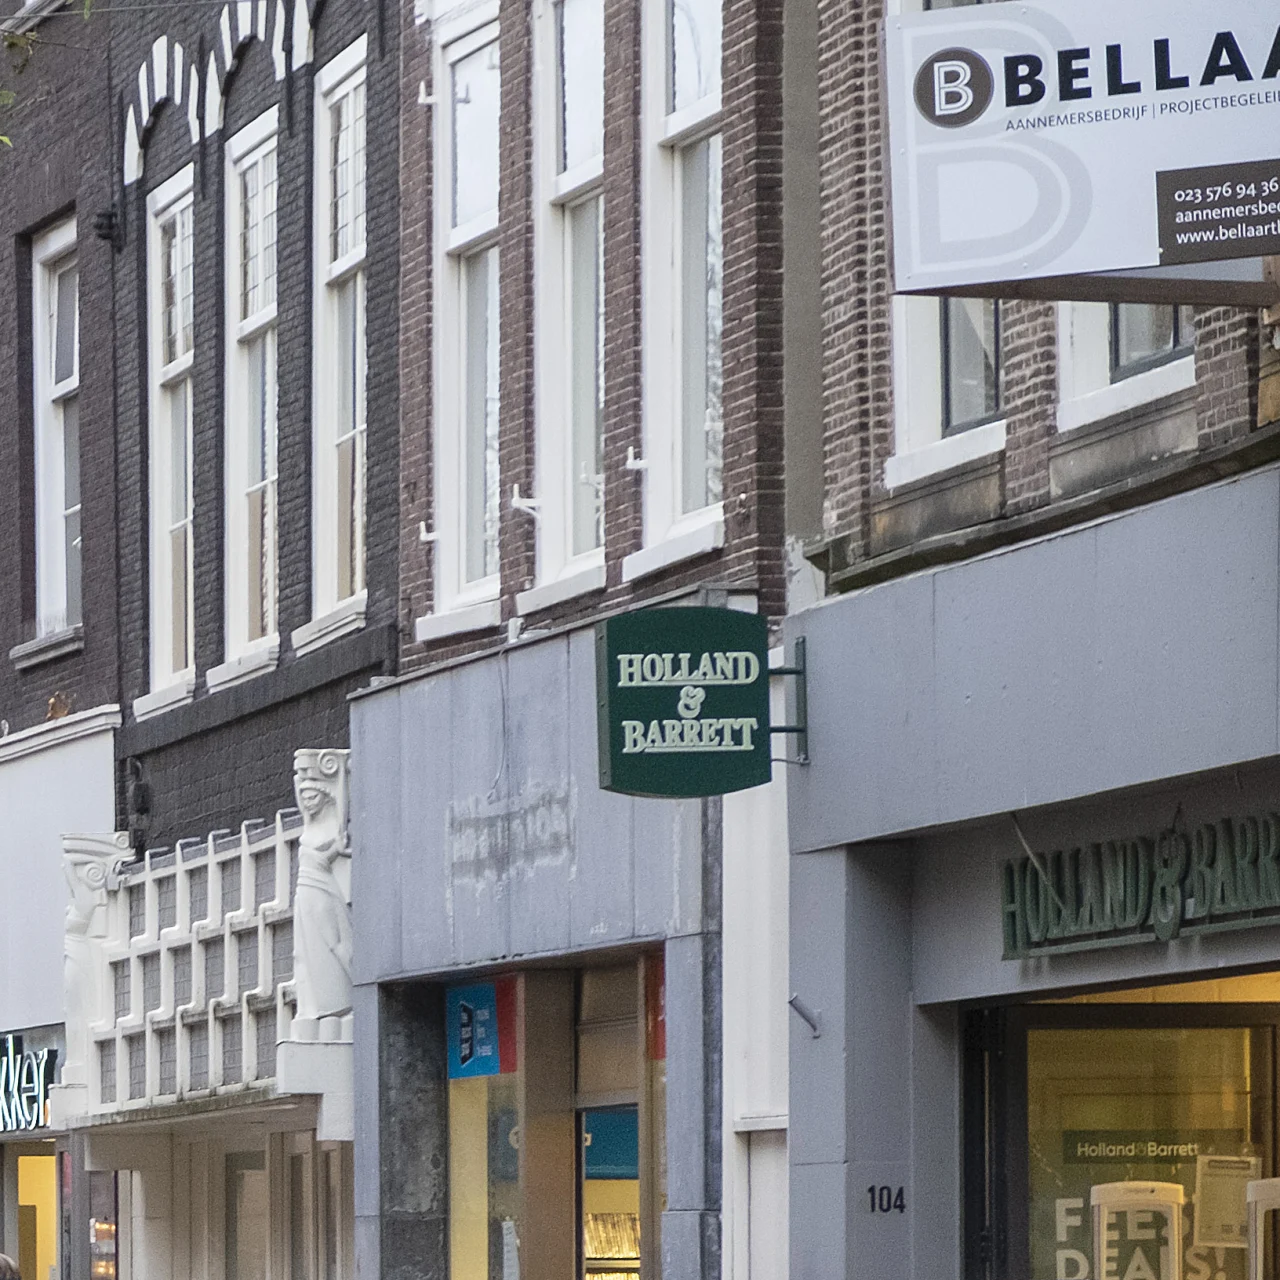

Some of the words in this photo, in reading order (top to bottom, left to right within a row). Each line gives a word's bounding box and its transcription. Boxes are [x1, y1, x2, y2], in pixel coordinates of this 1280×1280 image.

[1005, 104, 1148, 132] AANNEMERSBEDRIJF
[1160, 90, 1280, 116] PROJECTBEGELEI
[1175, 188, 1202, 204] 023
[1206, 181, 1232, 203] 576
[1236, 183, 1257, 199] 94
[1261, 177, 1280, 197] 36
[617, 652, 760, 687] HOLLAND
[677, 685, 706, 719] &
[621, 717, 759, 754] BARRETT
[1001, 836, 1154, 961] HOLLAND
[868, 1185, 906, 1213] 104
